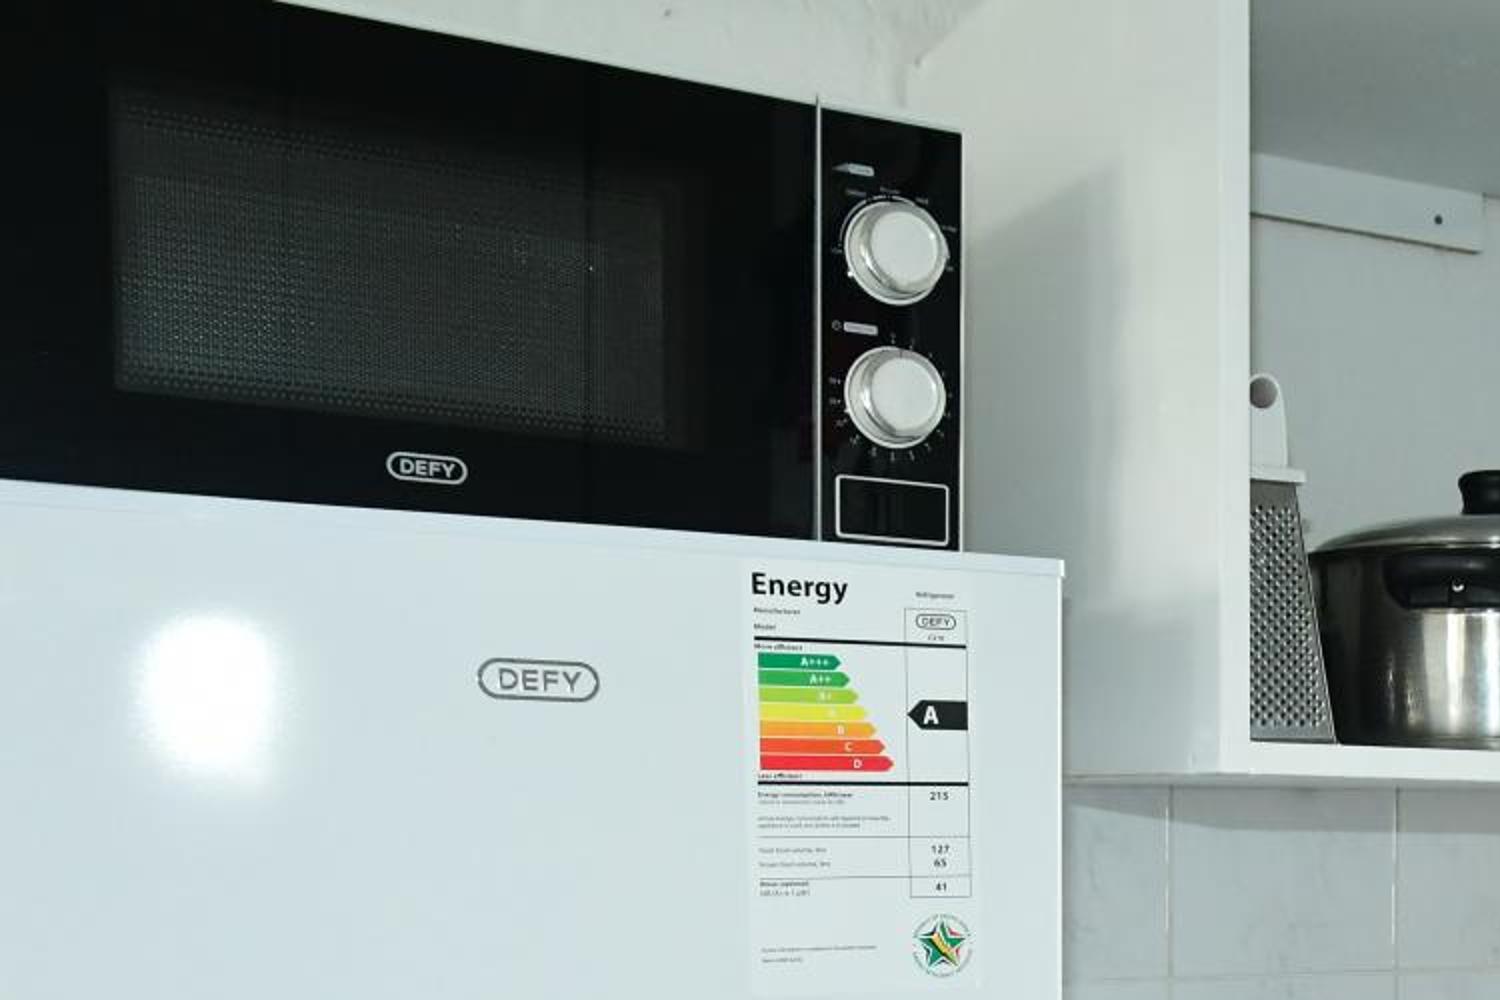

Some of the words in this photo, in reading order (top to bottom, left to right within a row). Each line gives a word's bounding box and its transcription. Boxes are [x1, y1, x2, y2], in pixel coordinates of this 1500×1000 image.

[400, 457, 456, 479] DEFY
[751, 571, 848, 605] Energy
[498, 666, 582, 693] DEFY
[923, 704, 940, 725] A
[844, 740, 854, 753] C
[852, 757, 863, 770] D
[929, 791, 949, 801] 215
[931, 844, 950, 854] 127
[933, 858, 947, 868] 65
[935, 881, 947, 892] 41
